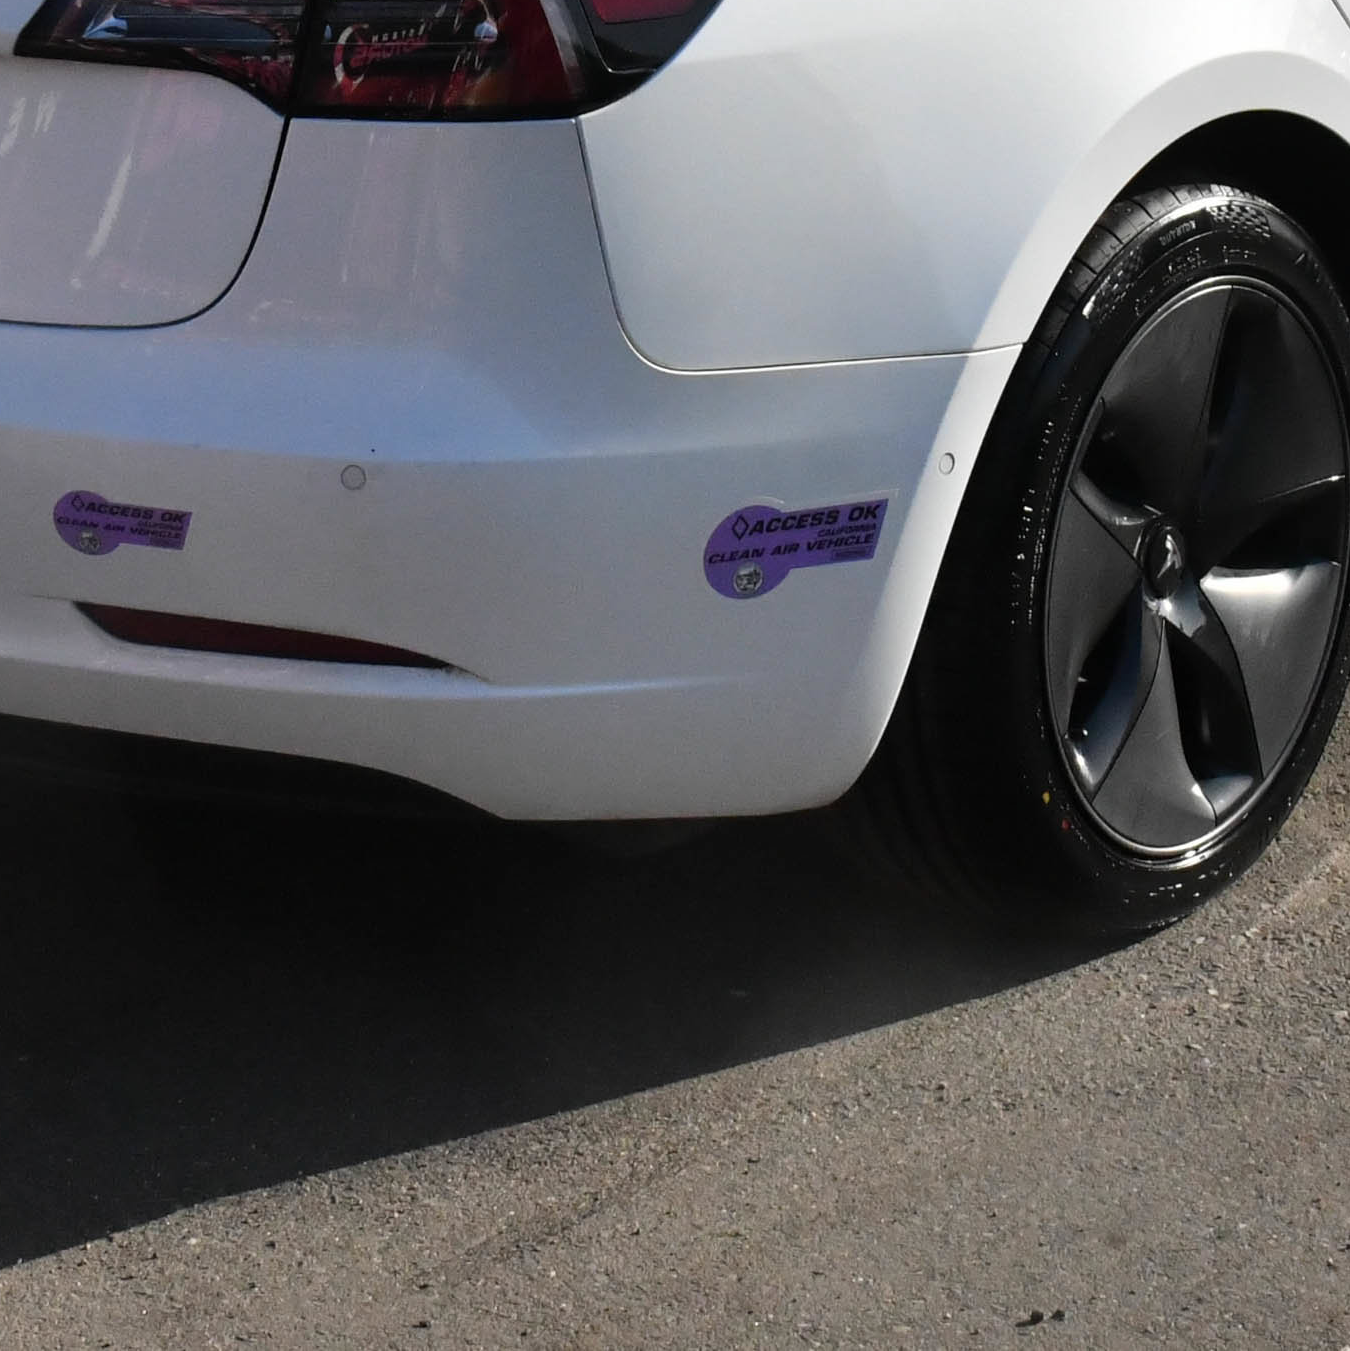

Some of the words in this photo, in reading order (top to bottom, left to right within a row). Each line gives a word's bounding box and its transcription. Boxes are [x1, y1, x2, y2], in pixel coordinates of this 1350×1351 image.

[85, 502, 154, 520] ACCESS
[160, 511, 187, 523] OK
[749, 509, 840, 536] ACCESS
[848, 504, 881, 521] OK
[57, 516, 99, 528] CLEAN
[103, 523, 125, 532] AIR
[130, 527, 183, 539] VEHICLE
[708, 547, 766, 565] CLEAN
[770, 544, 800, 556] AIR
[806, 534, 875, 551] VEHICLE
